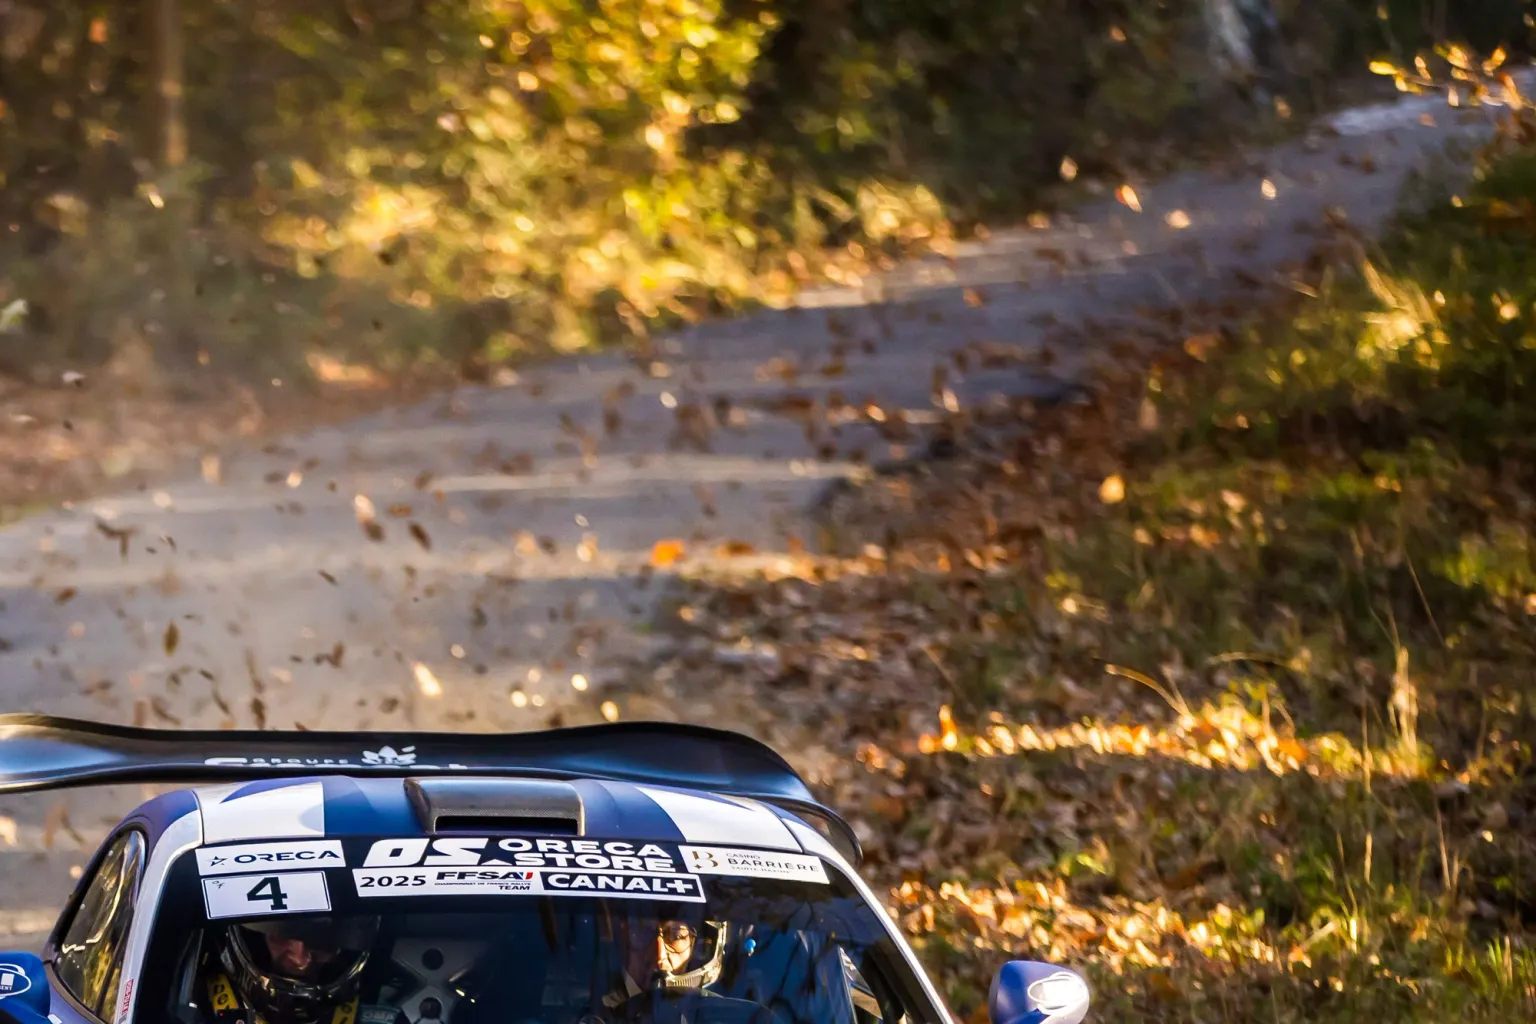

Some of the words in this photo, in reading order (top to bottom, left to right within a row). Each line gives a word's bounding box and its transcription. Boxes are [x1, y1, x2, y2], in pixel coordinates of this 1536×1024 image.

[234, 850, 340, 864] ORECA
[498, 838, 670, 858] ORECA
[514, 852, 676, 872] STORE
[360, 875, 426, 887] 2025
[436, 872, 523, 880] FFSA
[547, 874, 693, 893] CANAL+
[247, 876, 288, 911] 4
